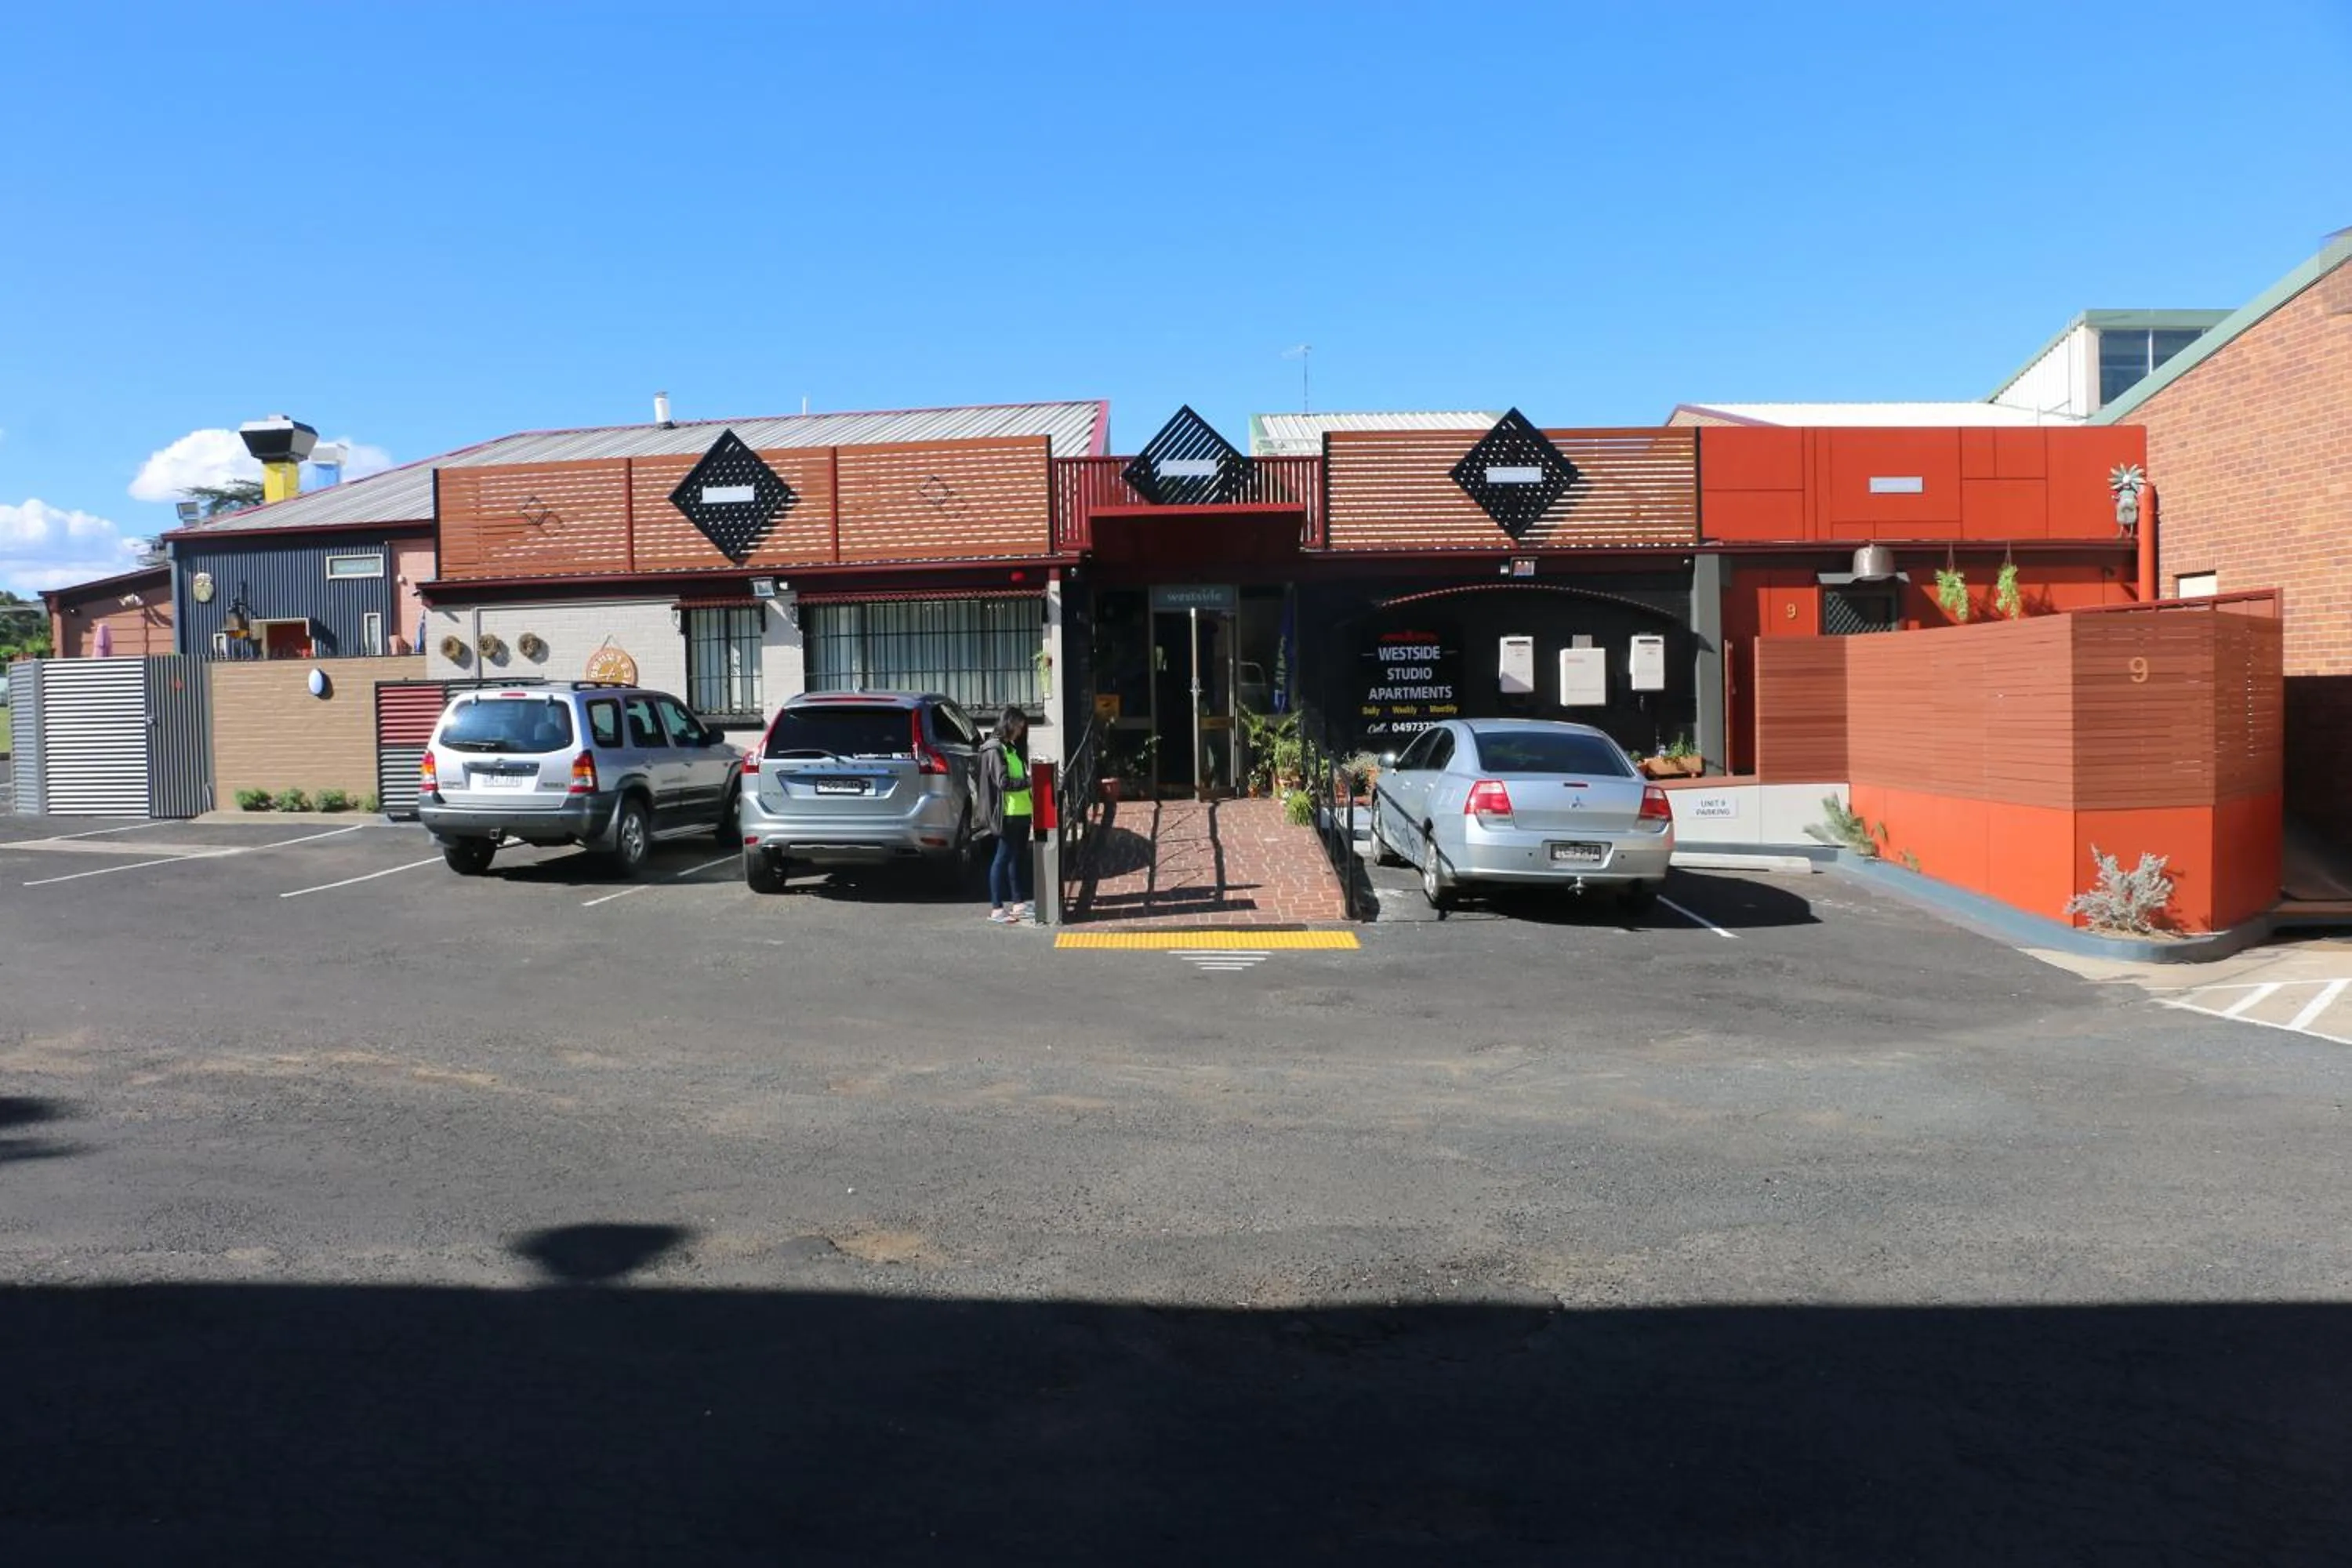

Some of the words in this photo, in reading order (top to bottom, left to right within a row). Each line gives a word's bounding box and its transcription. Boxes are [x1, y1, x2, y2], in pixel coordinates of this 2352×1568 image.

[1786, 603, 1796, 619] 9
[1378, 646, 1441, 660] WESTSIDE
[1387, 667, 1432, 680] STUDIO
[2129, 656, 2148, 683] 9
[1368, 686, 1453, 700] APARTMENTS
